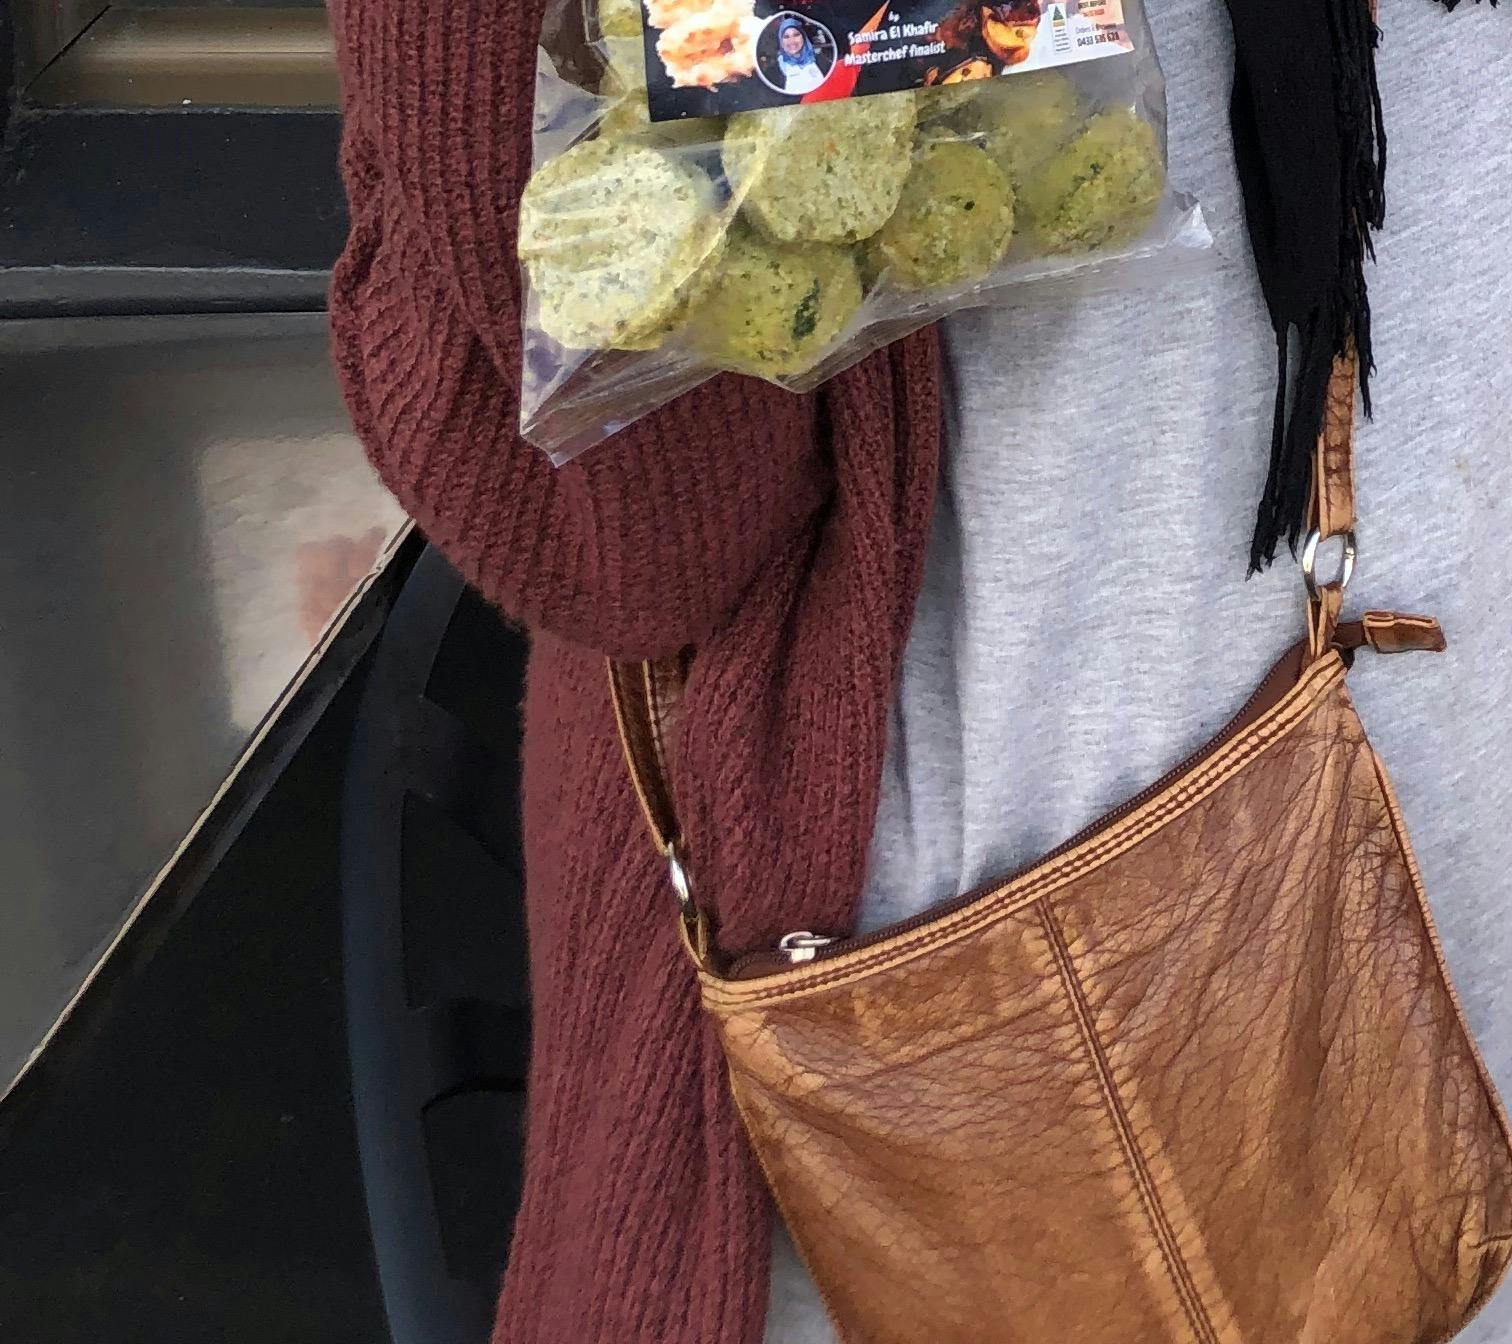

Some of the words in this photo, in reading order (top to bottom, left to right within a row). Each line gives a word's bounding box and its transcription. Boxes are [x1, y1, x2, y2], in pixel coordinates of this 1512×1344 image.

[847, 26, 888, 45] Samira
[889, 26, 901, 40] El
[902, 20, 939, 37] Khafir
[844, 46, 908, 66] Masterchef
[909, 41, 946, 57] finalist
